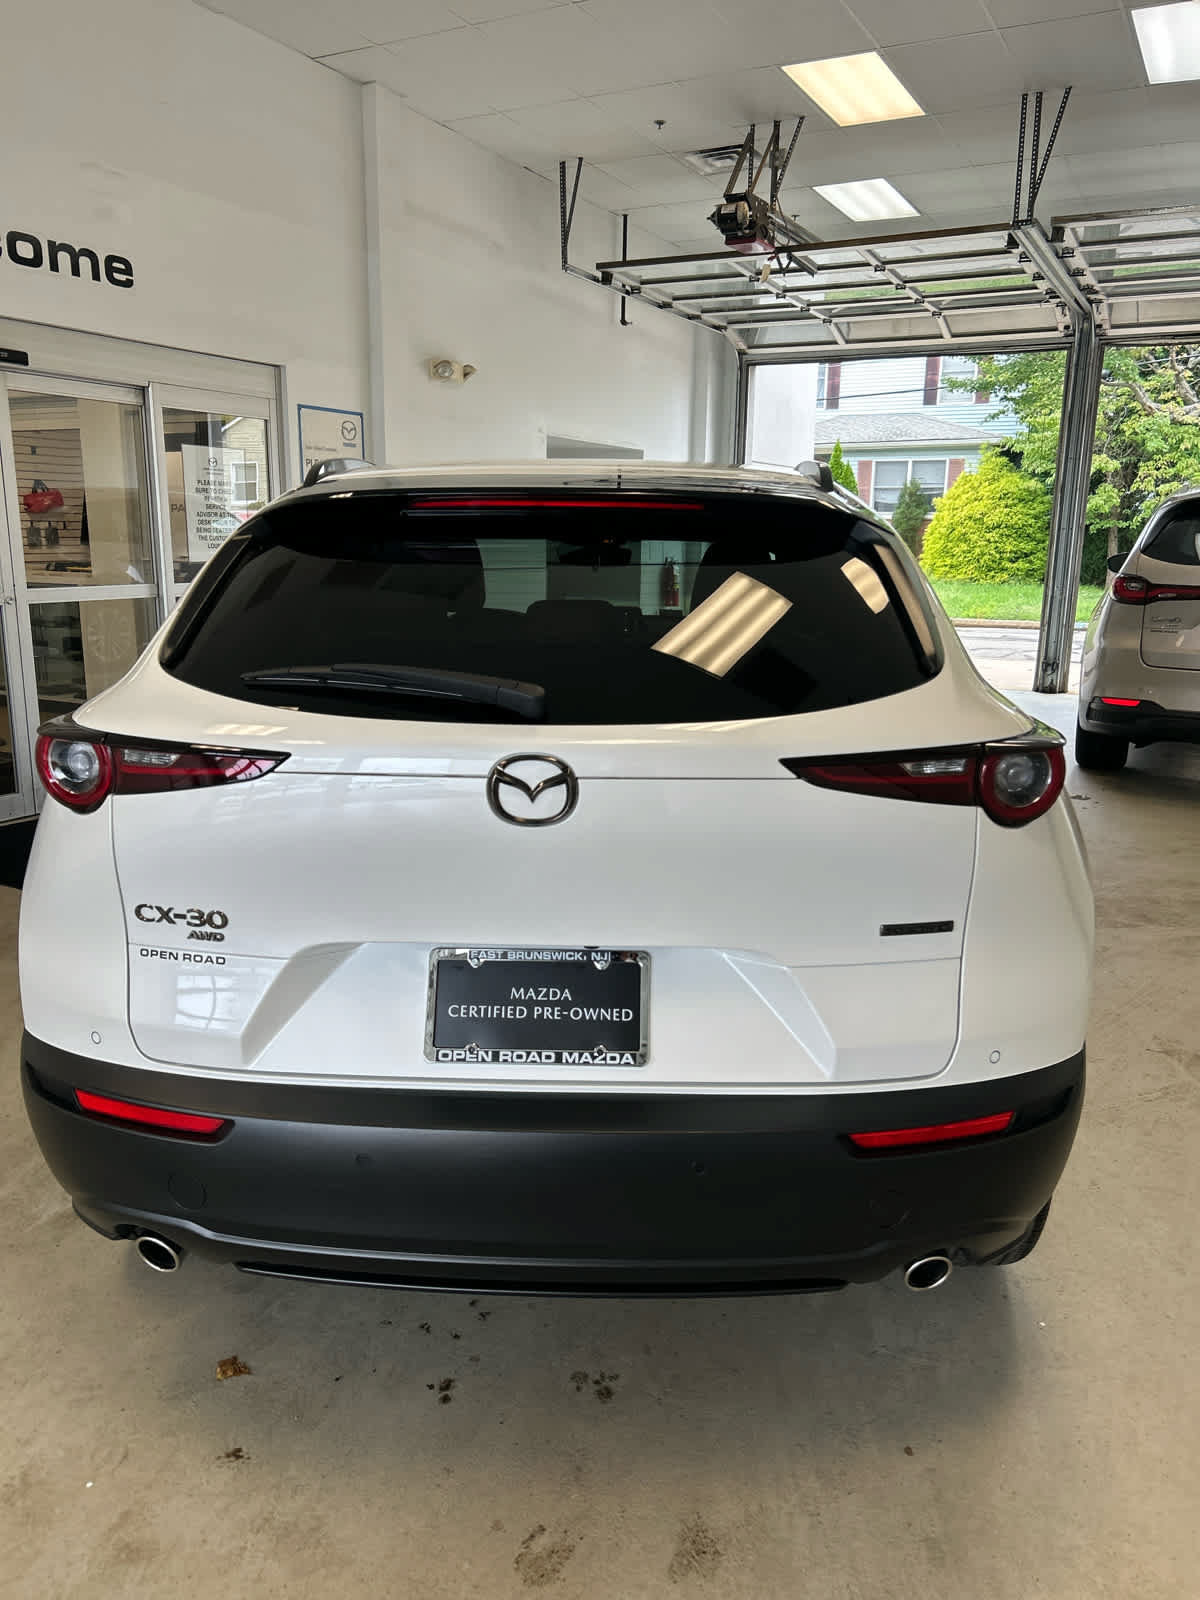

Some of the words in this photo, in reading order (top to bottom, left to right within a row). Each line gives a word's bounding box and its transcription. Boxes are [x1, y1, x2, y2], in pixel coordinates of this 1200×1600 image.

[0, 230, 134, 289] ome
[134, 903, 229, 930] CX-30
[187, 930, 225, 942] AWD
[140, 948, 179, 961] OPEN
[182, 953, 226, 965] ROAD
[591, 951, 608, 961] NJ
[510, 987, 573, 1001] MAZDA
[448, 1004, 528, 1019] CERTIFIED
[533, 1007, 634, 1022] PRE-OWNED
[438, 1049, 493, 1063] OPEN
[499, 1050, 556, 1064] ROAD
[562, 1051, 635, 1065] MAZDA
